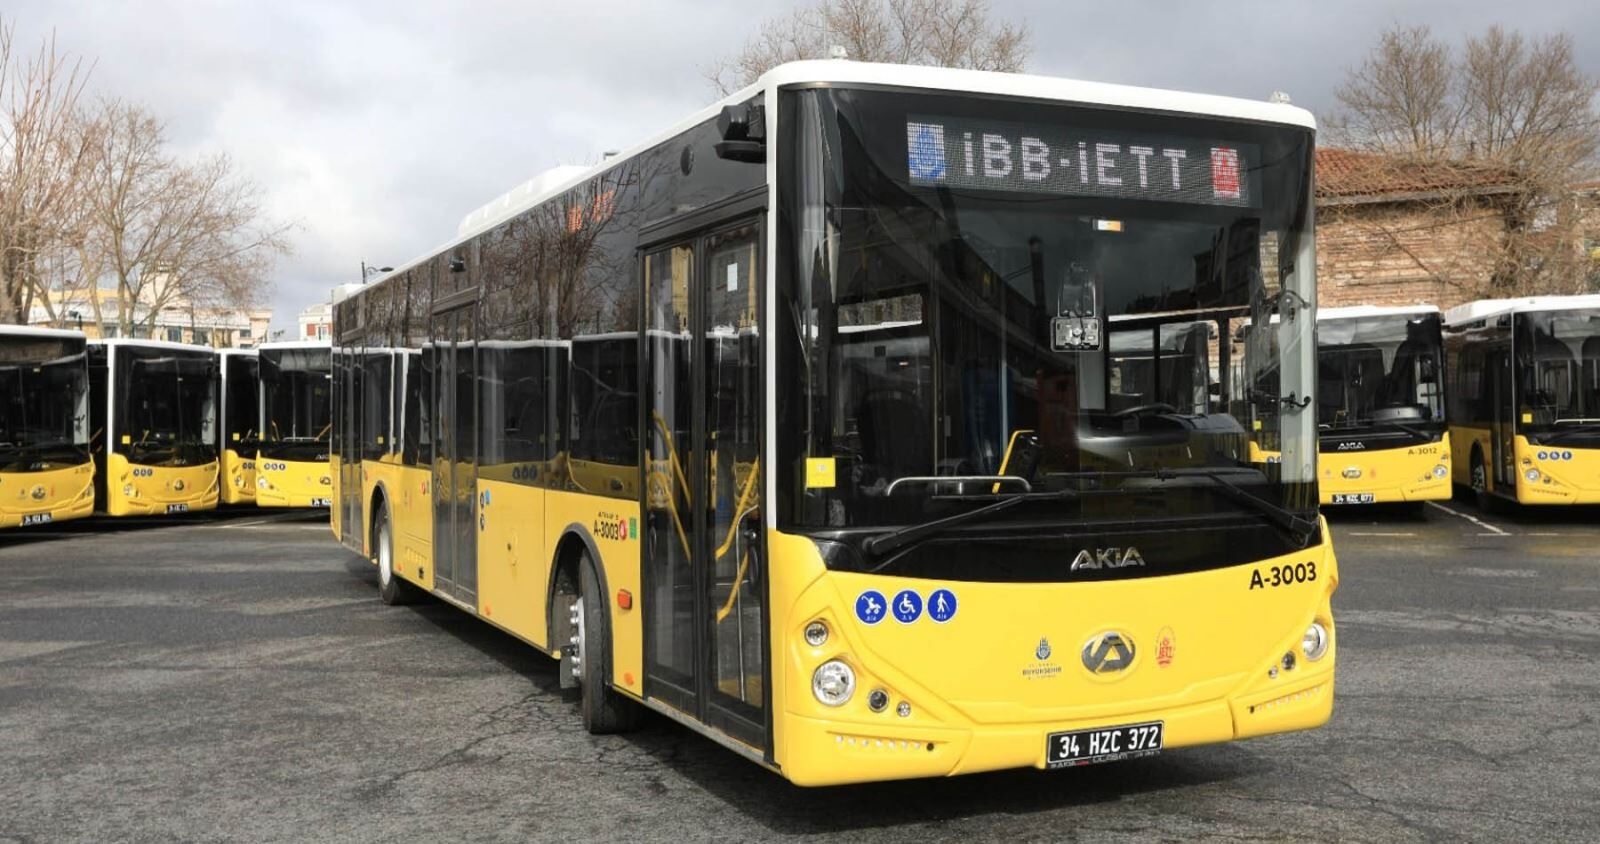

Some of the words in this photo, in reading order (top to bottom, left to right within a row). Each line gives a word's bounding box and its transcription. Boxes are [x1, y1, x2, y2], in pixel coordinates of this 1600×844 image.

[593, 520, 619, 540] A-3003
[1071, 547, 1146, 571] AKIA
[1249, 561, 1317, 590] A-3003
[1059, 735, 1080, 758] 34
[1089, 730, 1121, 755] HZC
[1128, 726, 1159, 750] 372
